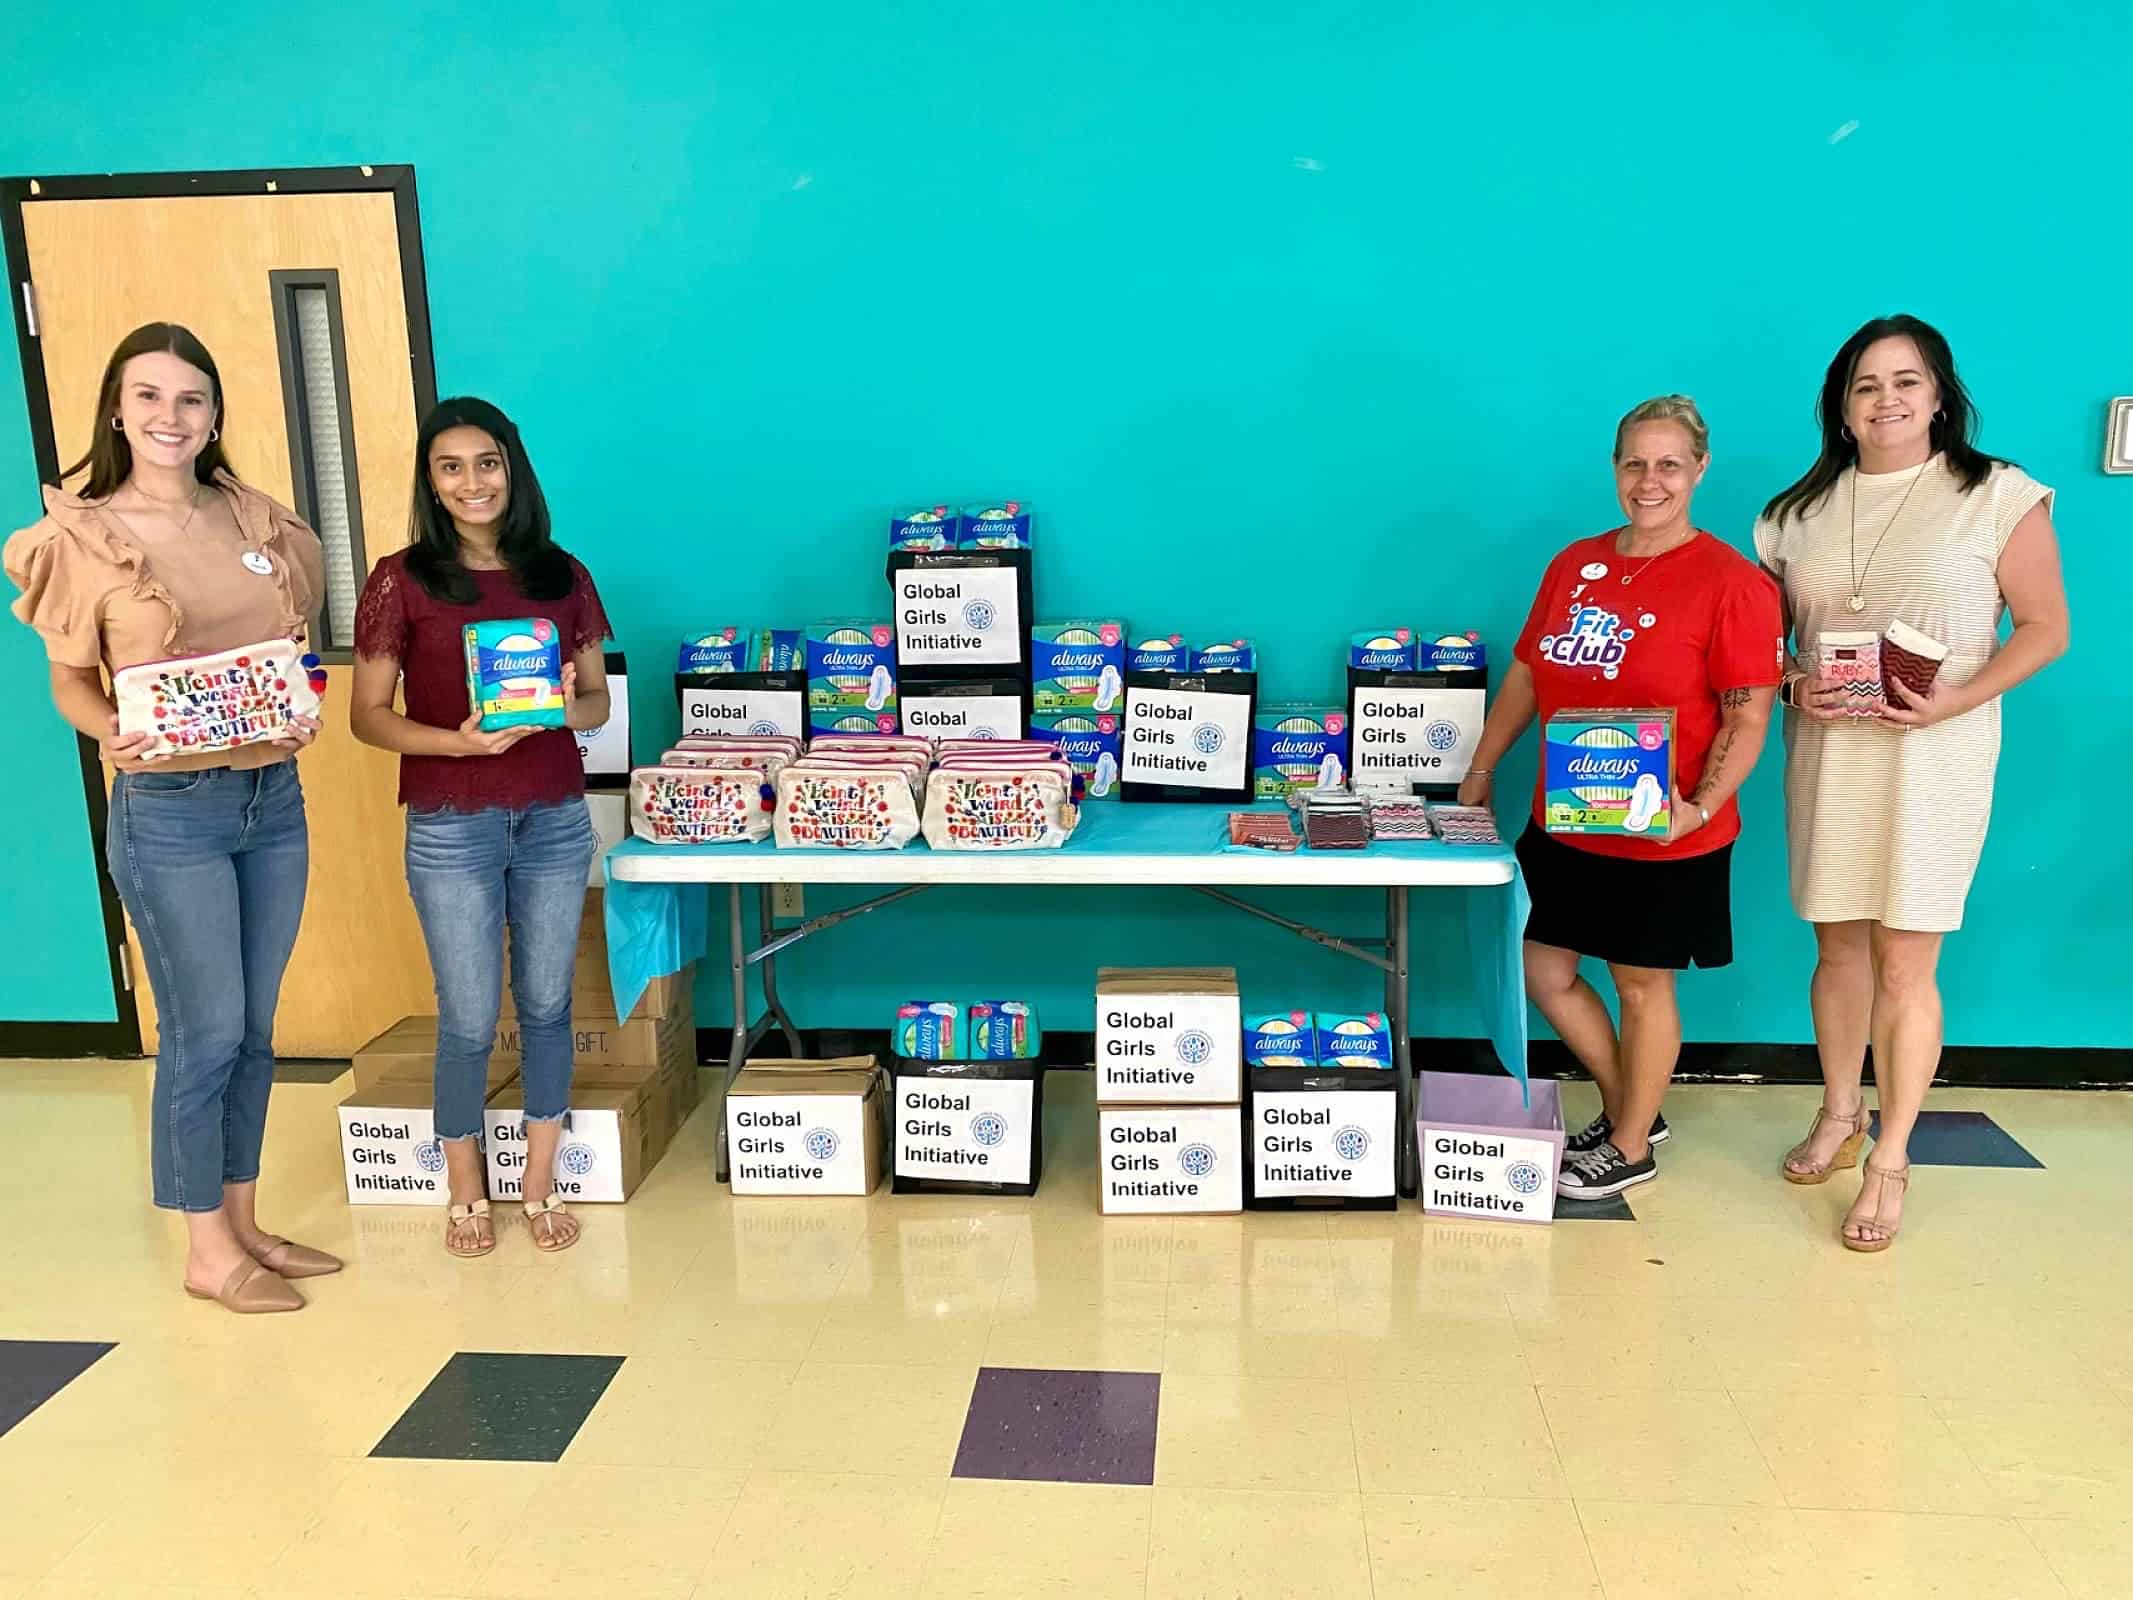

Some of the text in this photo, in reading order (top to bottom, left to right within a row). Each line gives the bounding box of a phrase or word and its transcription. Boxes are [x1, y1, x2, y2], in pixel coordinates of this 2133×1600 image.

[901, 524, 944, 536] always
[972, 521, 1016, 535] always
[904, 584, 960, 599] Global
[905, 610, 946, 624] Girls
[1573, 609, 1617, 637] Fit
[907, 634, 981, 649] Initiative
[1551, 635, 1623, 664] Club
[493, 654, 549, 673] always
[690, 649, 735, 664] always
[823, 650, 874, 670] always
[1052, 650, 1104, 670] always
[1134, 652, 1177, 666] always
[1199, 653, 1242, 666] always
[1361, 649, 1405, 666] always
[1431, 648, 1475, 663] always
[832, 695, 839, 705] 2
[1058, 696, 1066, 706] 2
[218, 703, 237, 720] is
[691, 704, 746, 719] Global
[911, 711, 966, 725] Global
[1135, 703, 1192, 720] Global
[1363, 703, 1423, 718] Global
[1133, 728, 1174, 744] Girls
[1362, 728, 1406, 743] Girls
[1271, 737, 1327, 759] always
[1132, 751, 1208, 772] Initiative
[1362, 753, 1441, 767] Initiative
[1567, 752, 1640, 780] always
[1279, 783, 1286, 792] 2
[688, 810, 700, 822] is
[832, 813, 844, 825] is
[989, 812, 1003, 825] is
[1578, 809, 1587, 824] 2
[1107, 1012, 1172, 1028] Global
[575, 1031, 609, 1053] GIFT.
[991, 1017, 1008, 1055] always
[1255, 1036, 1303, 1051] always
[1107, 1040, 1155, 1056] Girls
[1330, 1037, 1378, 1052] always
[1108, 1068, 1194, 1084] Initiative
[906, 1093, 969, 1110] Global
[737, 1112, 800, 1127] Global
[1264, 1108, 1330, 1124] Global
[350, 1123, 409, 1139] Global
[494, 1125, 528, 1141] Glo
[906, 1120, 951, 1136] Girls
[1111, 1127, 1176, 1143] Global
[739, 1138, 784, 1153] Girls
[1264, 1136, 1312, 1152] Girls
[1435, 1139, 1503, 1157] Global
[353, 1148, 396, 1164] Girls
[496, 1152, 528, 1168] Gir
[905, 1145, 989, 1165] Initiative
[1112, 1155, 1159, 1170] Girls
[740, 1164, 823, 1178] Initiative
[1265, 1164, 1352, 1181] Initiative
[1435, 1165, 1484, 1182] Girls
[355, 1174, 435, 1190] Initiative
[1112, 1181, 1198, 1196] Initiative
[1434, 1189, 1525, 1213] Initiative
